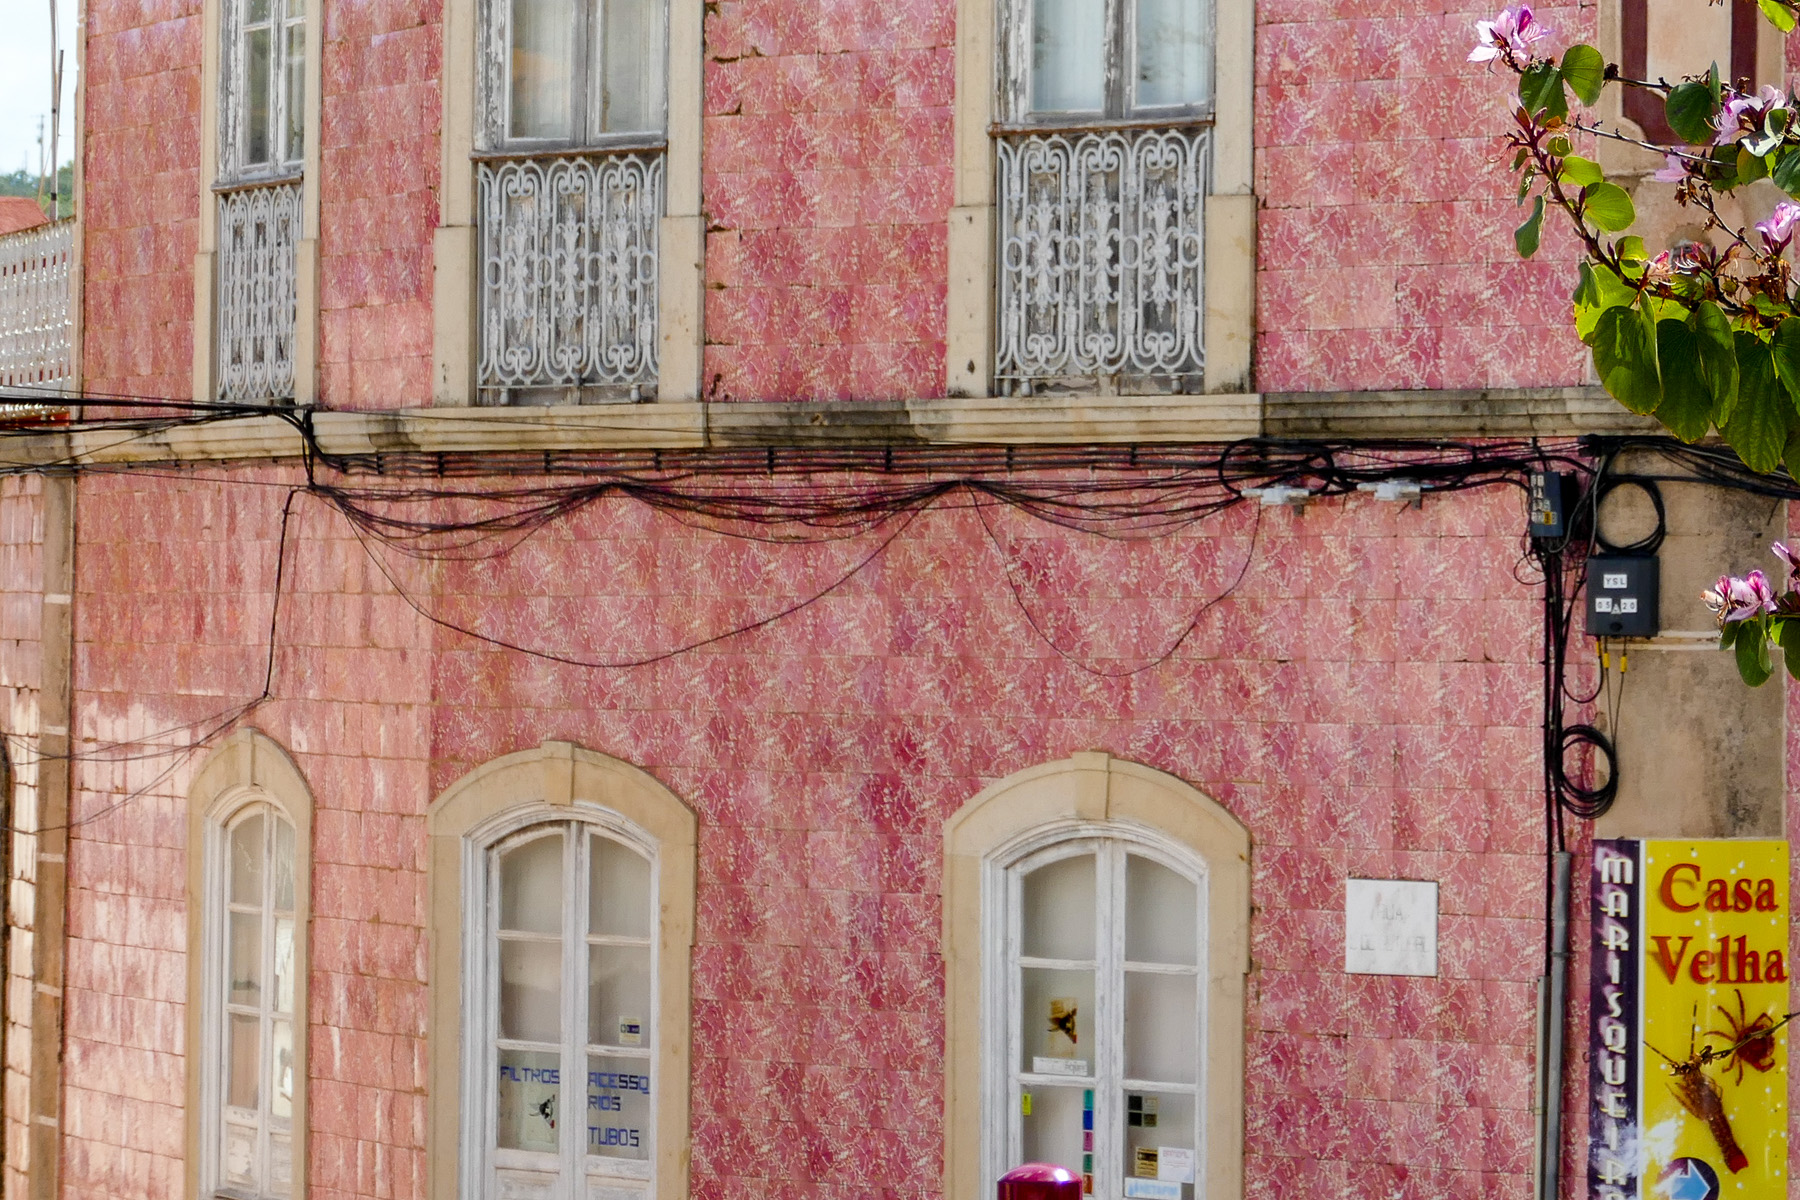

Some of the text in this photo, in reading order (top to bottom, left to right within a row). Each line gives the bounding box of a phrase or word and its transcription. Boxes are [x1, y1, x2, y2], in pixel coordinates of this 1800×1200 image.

[1606, 577, 1625, 586] YSL
[1622, 602, 1636, 610] 20
[1660, 863, 1779, 913] Casa
[1651, 935, 1789, 985] Velha
[1598, 856, 1635, 1200] MARISQUEIR
[500, 1066, 560, 1084] FILTROS
[588, 1096, 621, 1111] RIOS
[588, 1127, 639, 1147] TUBOS
